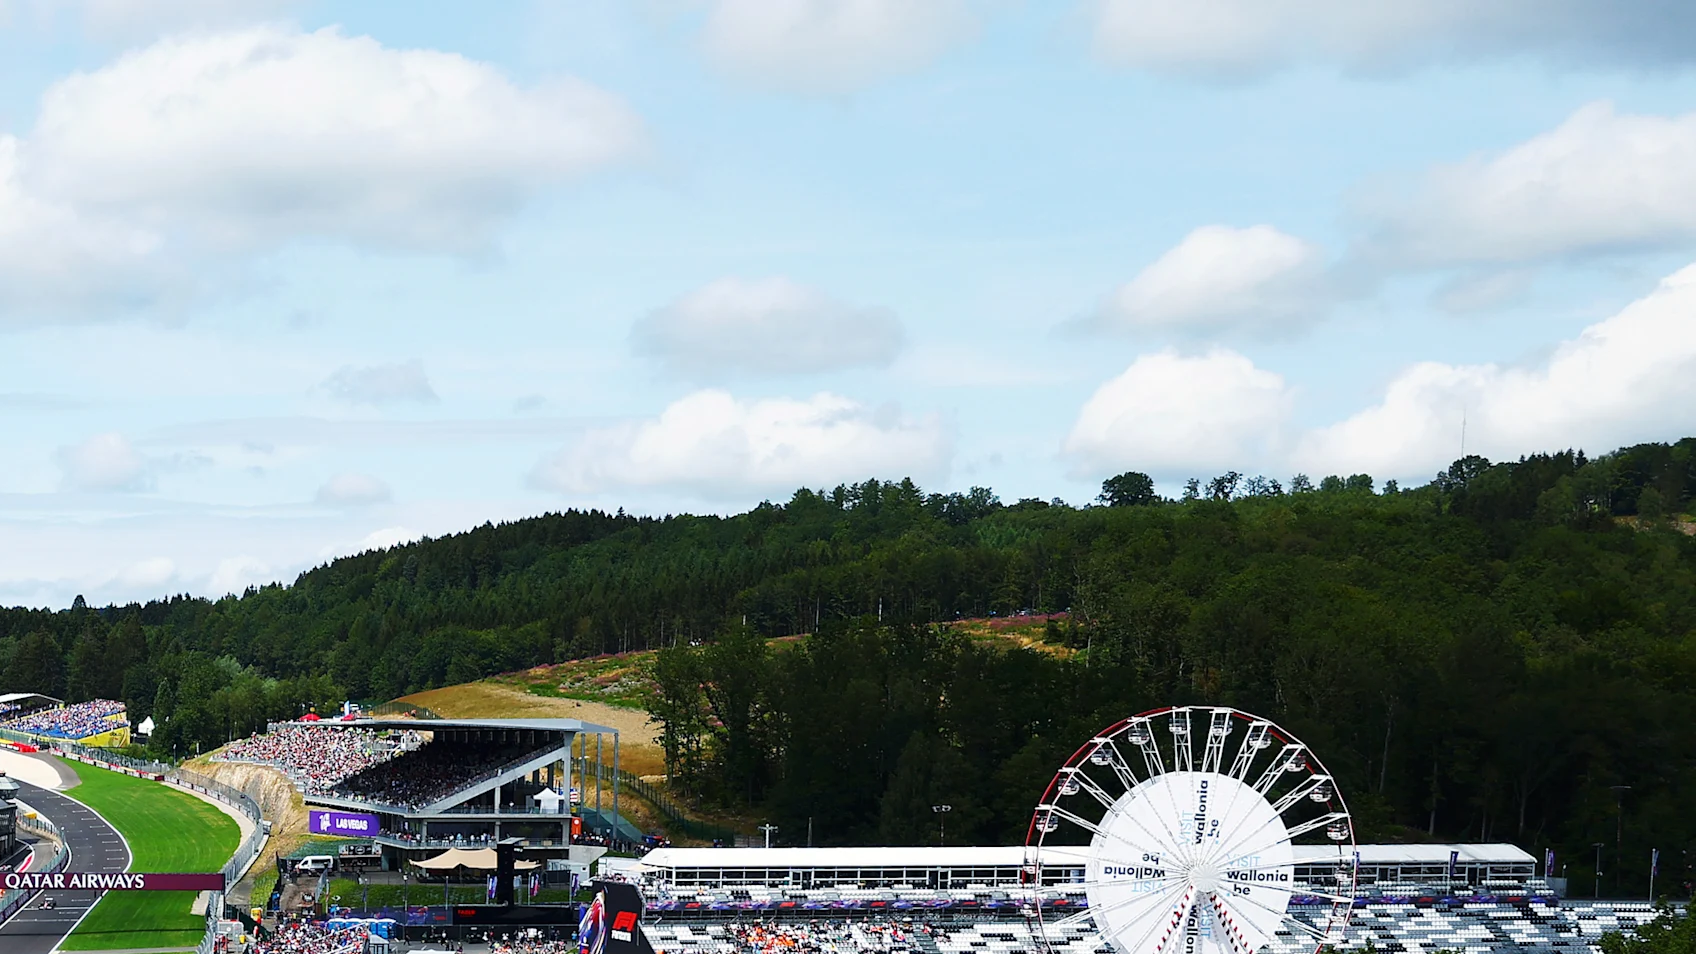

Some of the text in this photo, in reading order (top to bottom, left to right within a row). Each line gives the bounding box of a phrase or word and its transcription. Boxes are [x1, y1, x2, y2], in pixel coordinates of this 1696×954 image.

[336, 818, 368, 830] LAS VEGAS
[5, 874, 145, 890] QATAR AIRWAYS
